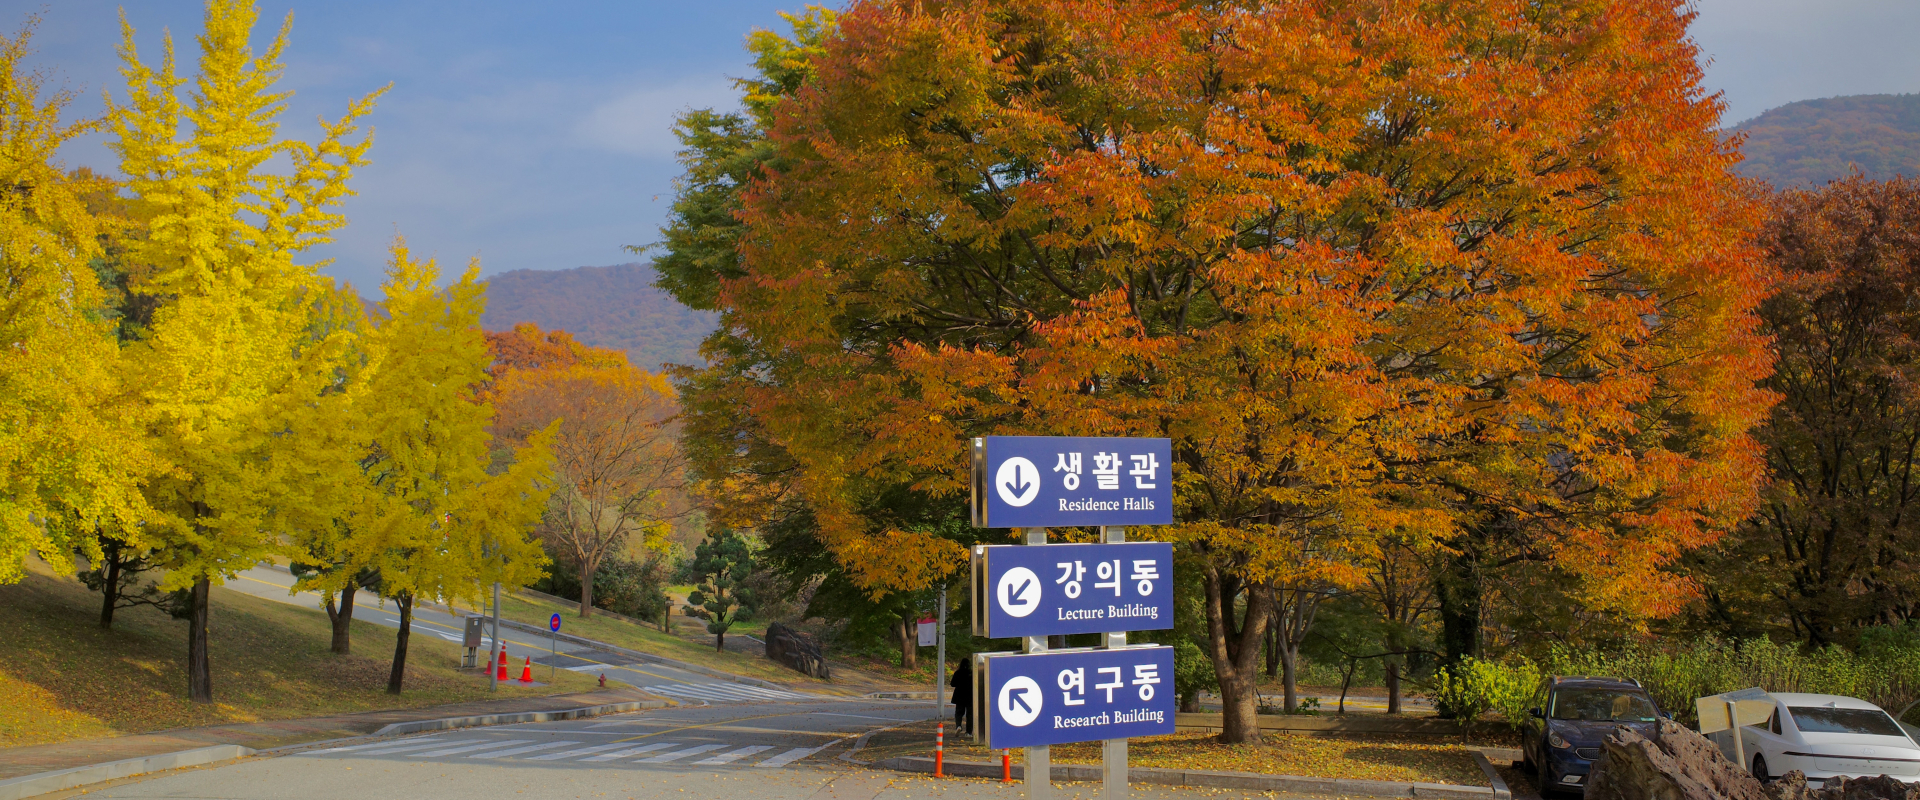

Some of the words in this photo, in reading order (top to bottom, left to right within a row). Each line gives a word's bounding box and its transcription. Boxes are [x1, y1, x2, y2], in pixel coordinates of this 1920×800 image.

[1053, 452, 1160, 491] 생활관
[1058, 498, 1120, 512] Residence
[1123, 497, 1155, 511] Halls
[1056, 559, 1160, 599] 강의동
[1057, 608, 1104, 621] Lecture
[1107, 604, 1158, 620] Building
[1057, 663, 1161, 706] 연구동
[1053, 711, 1110, 729] Research
[1113, 708, 1165, 724] Building
